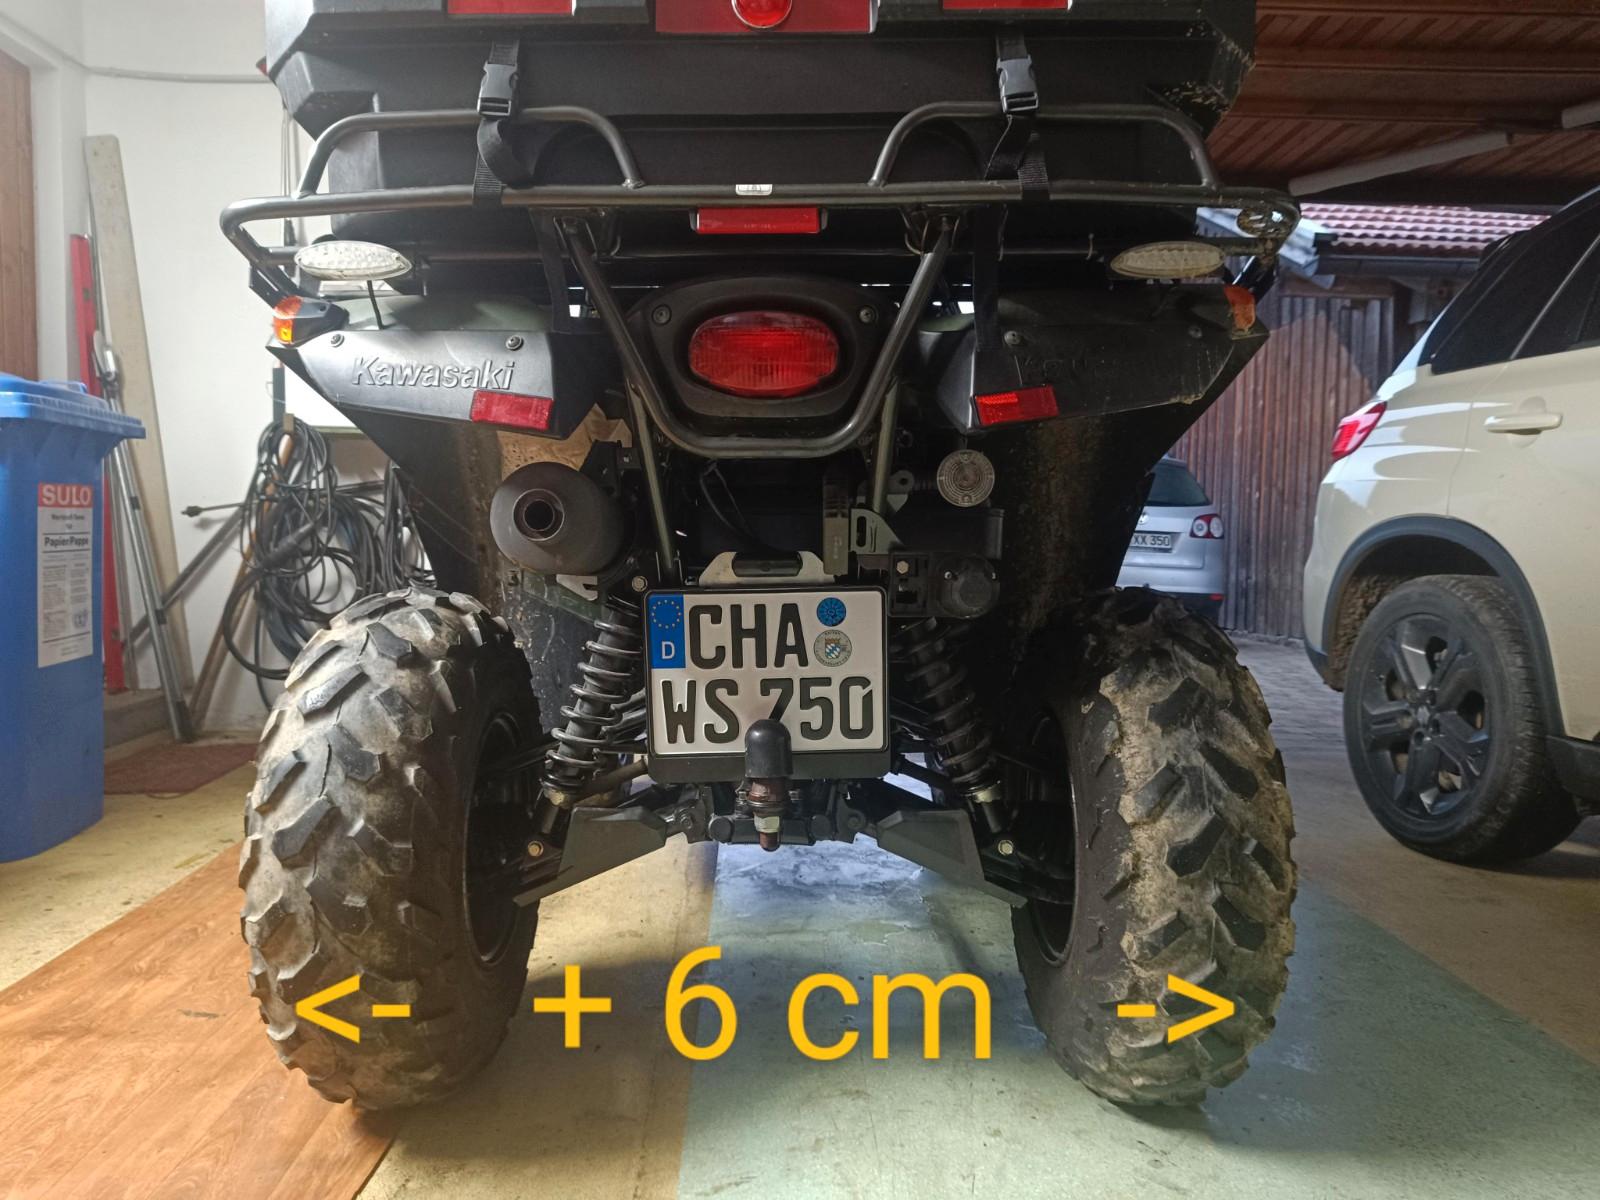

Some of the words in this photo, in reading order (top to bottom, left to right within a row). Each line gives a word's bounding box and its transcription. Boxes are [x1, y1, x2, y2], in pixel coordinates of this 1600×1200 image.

[352, 356, 516, 390] Kawasaki
[42, 484, 92, 506] SULO
[1150, 535, 1170, 547] 350
[661, 640, 676, 660] D
[688, 603, 809, 670] CHA
[661, 679, 740, 744] WS
[759, 676, 874, 741] 750
